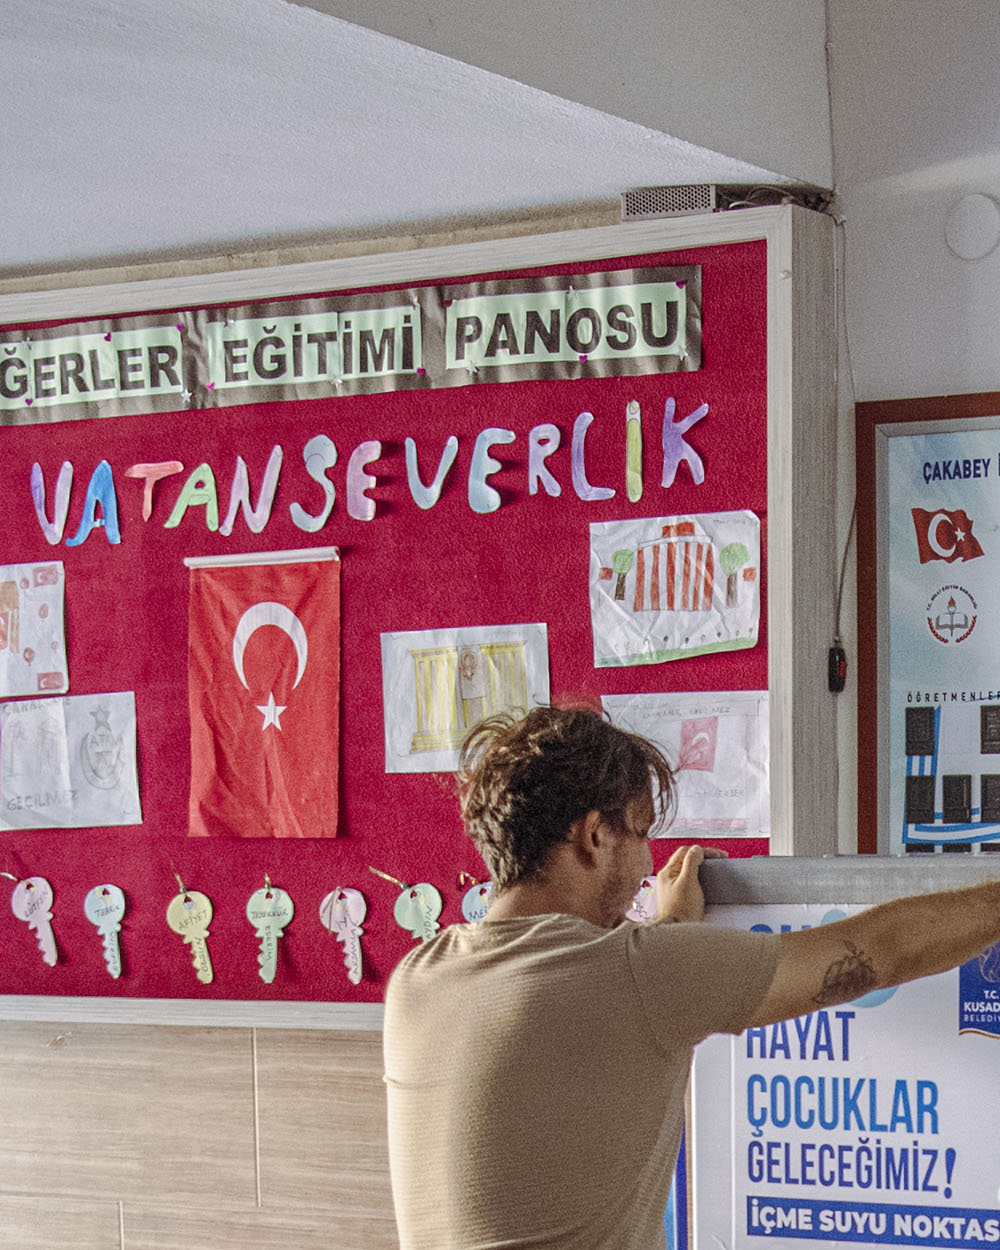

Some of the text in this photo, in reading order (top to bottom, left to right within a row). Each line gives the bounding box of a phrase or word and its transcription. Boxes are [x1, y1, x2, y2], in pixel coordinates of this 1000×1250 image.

[223, 316, 415, 383] EĞİTİMİ
[454, 300, 679, 362] PANOSU
[922, 457, 991, 484] ÇAKABEY
[746, 1010, 856, 1062] HAYAT
[746, 1073, 940, 1138] ÇOCUKLAR
[751, 1198, 813, 1234] İÇME
[818, 1209, 887, 1236] SUYU
